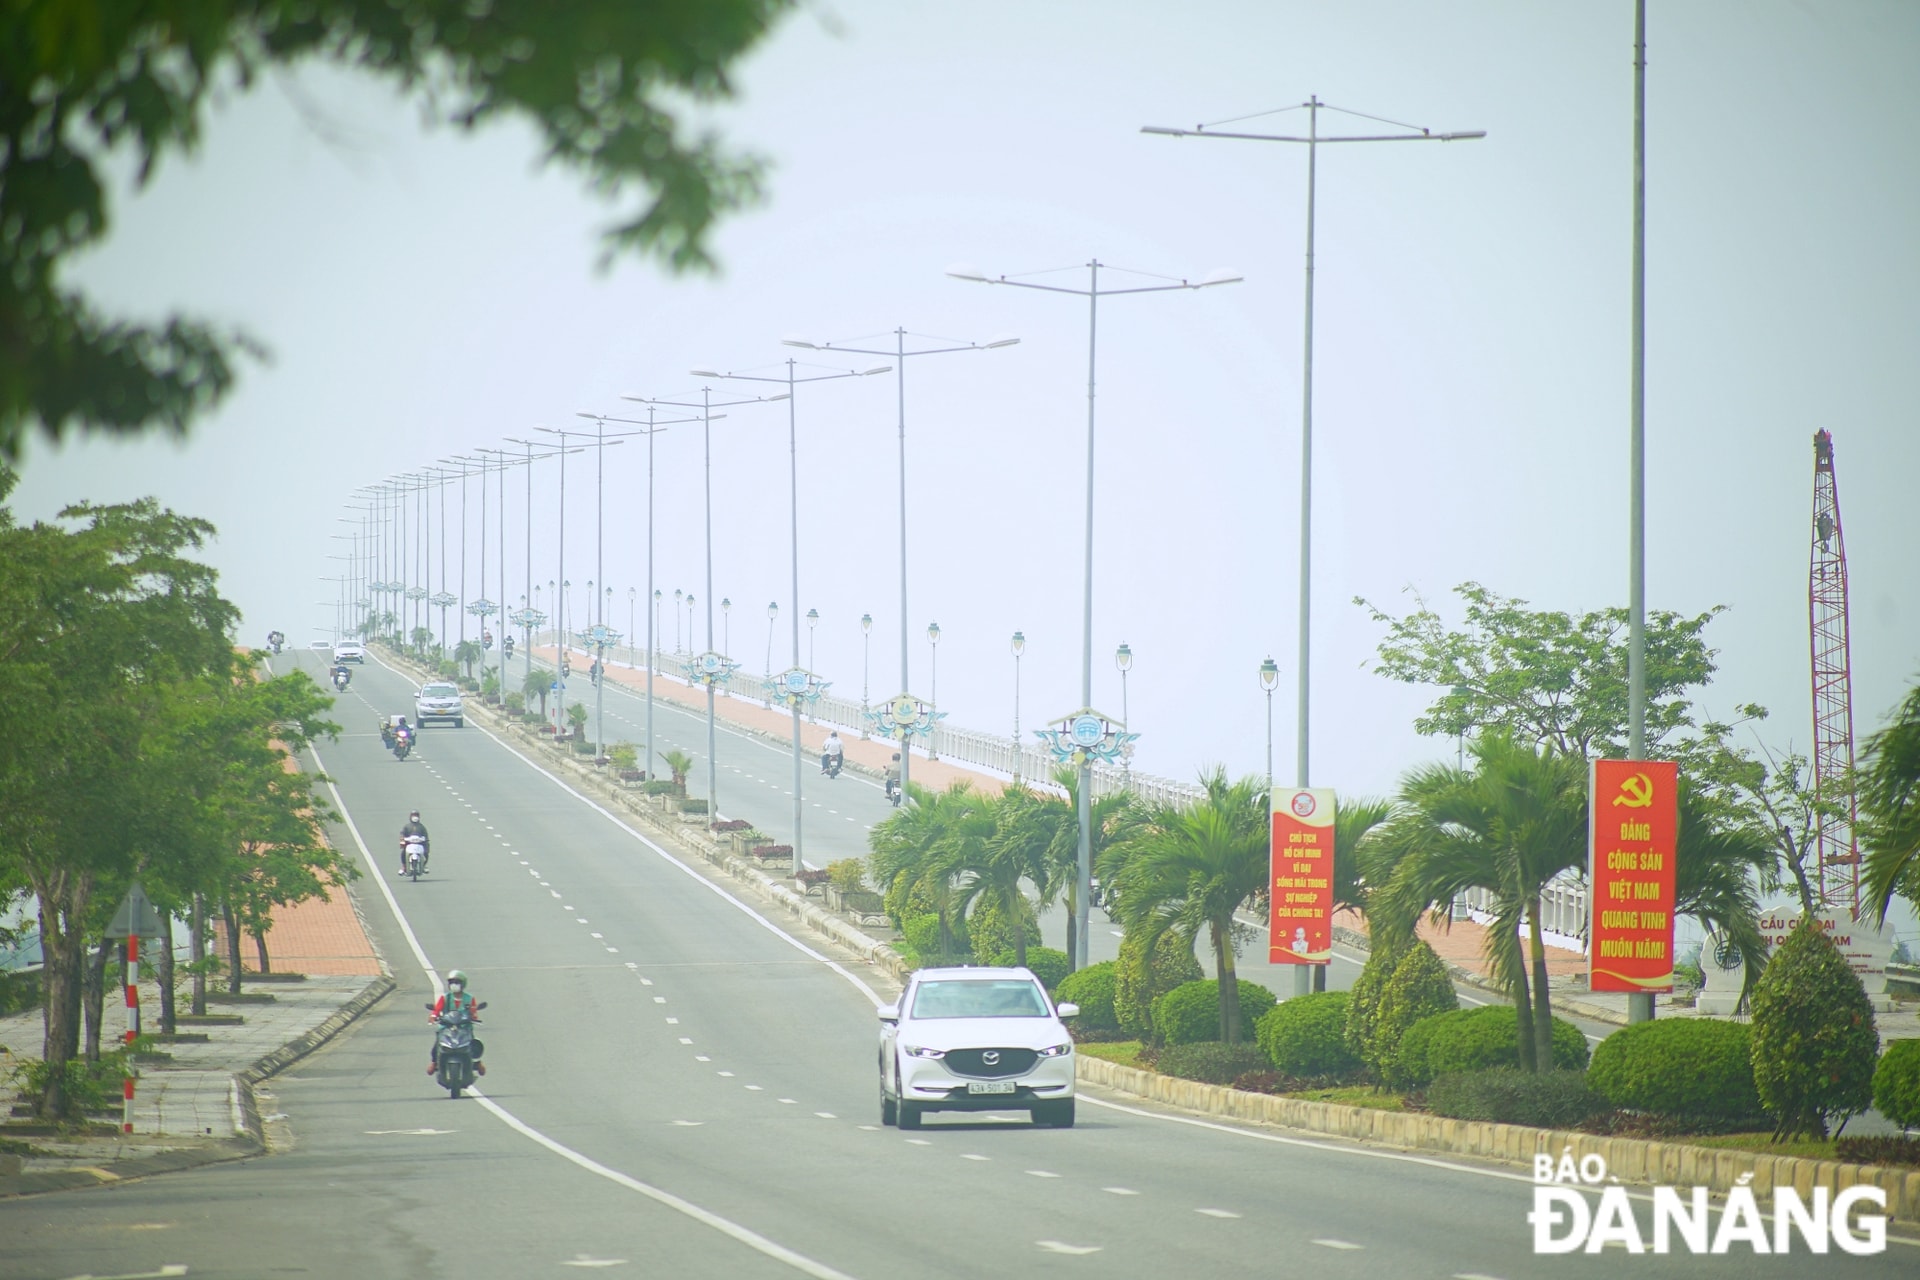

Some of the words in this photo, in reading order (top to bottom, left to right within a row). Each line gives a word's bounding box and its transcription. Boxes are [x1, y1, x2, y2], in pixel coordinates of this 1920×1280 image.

[1621, 817, 1650, 841] ĐẢNG
[1607, 848, 1637, 873] CỘNG
[1640, 847, 1663, 871] SẢN
[1609, 878, 1632, 903] VIỆT
[1634, 882, 1660, 900] NAM
[1601, 910, 1638, 930] QUANG
[1640, 911, 1666, 930] VINH
[1600, 937, 1633, 958] MUÔN
[1635, 938, 1665, 960] NĂM!
